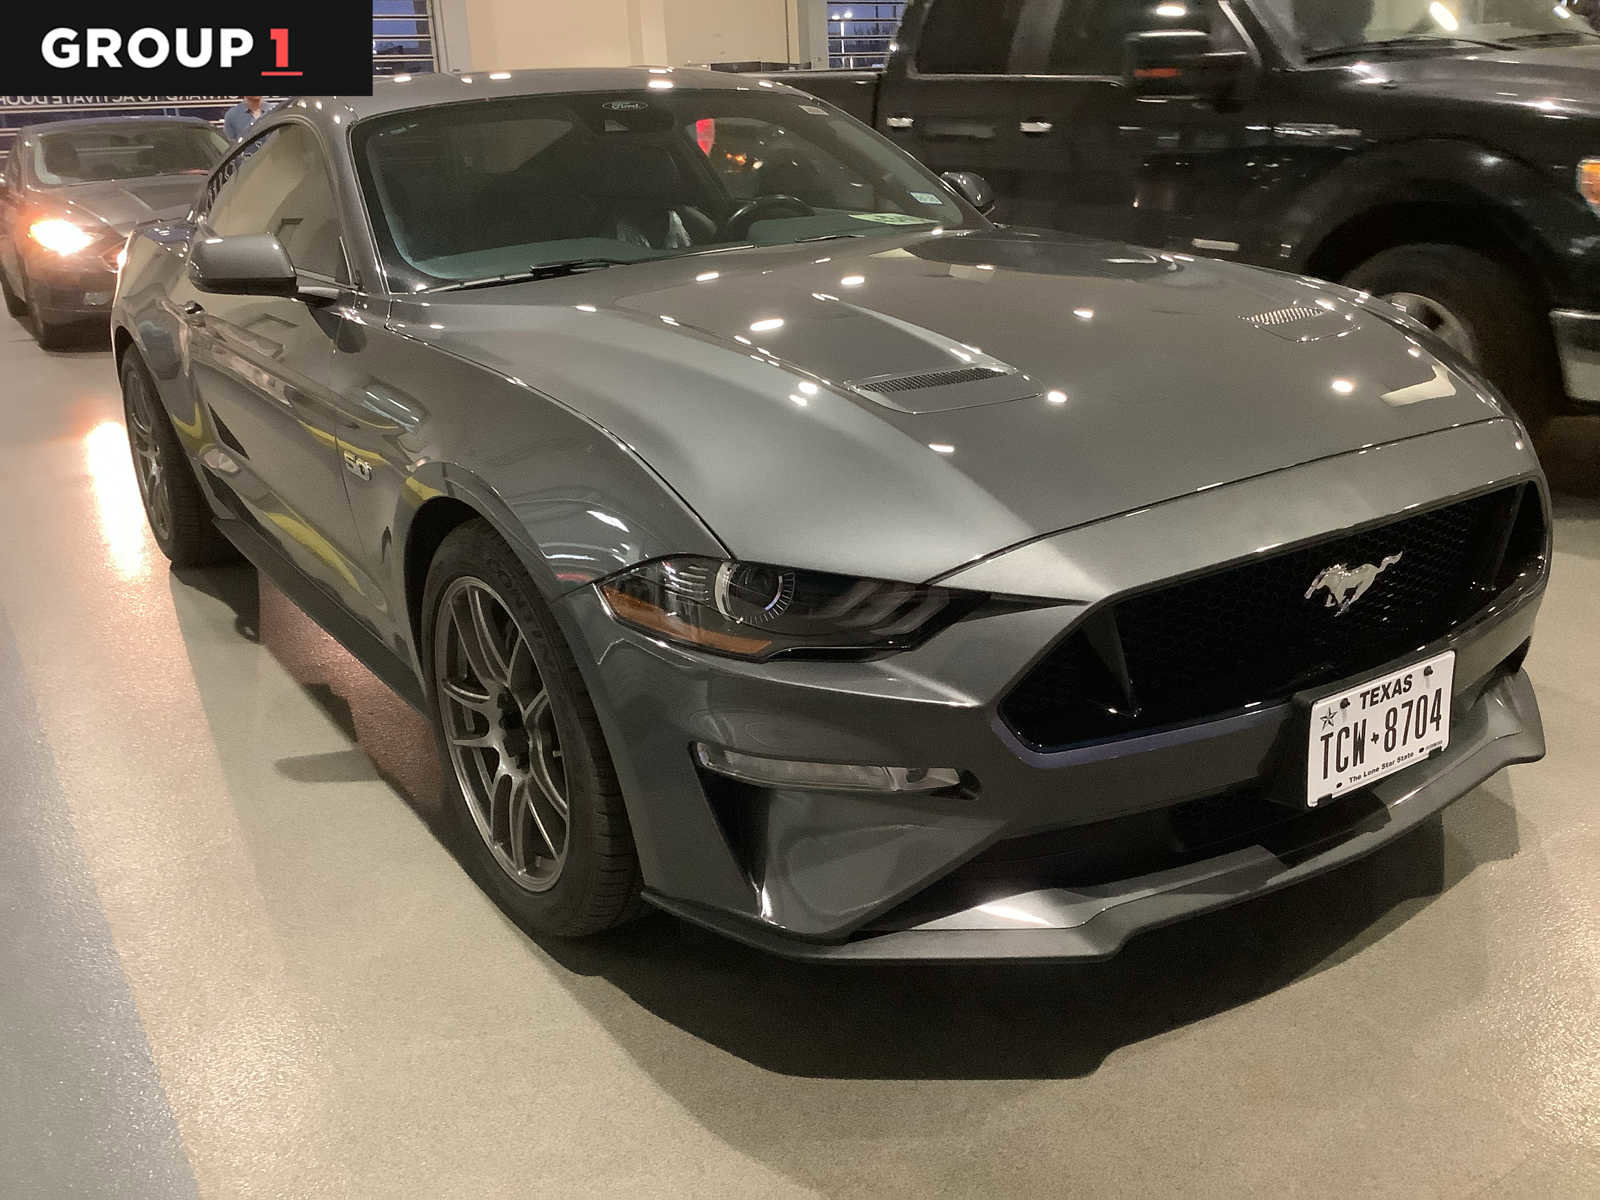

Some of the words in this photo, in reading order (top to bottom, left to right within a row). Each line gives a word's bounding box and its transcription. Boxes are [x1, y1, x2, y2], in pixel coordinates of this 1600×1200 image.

[1360, 673, 1413, 710] TEXAS
[1320, 718, 1367, 780] TCW
[1383, 687, 1443, 753] 8704
[1349, 775, 1362, 783] The
[1363, 766, 1380, 777] Lone
[1381, 760, 1395, 770] Star
[1397, 752, 1414, 763] State
